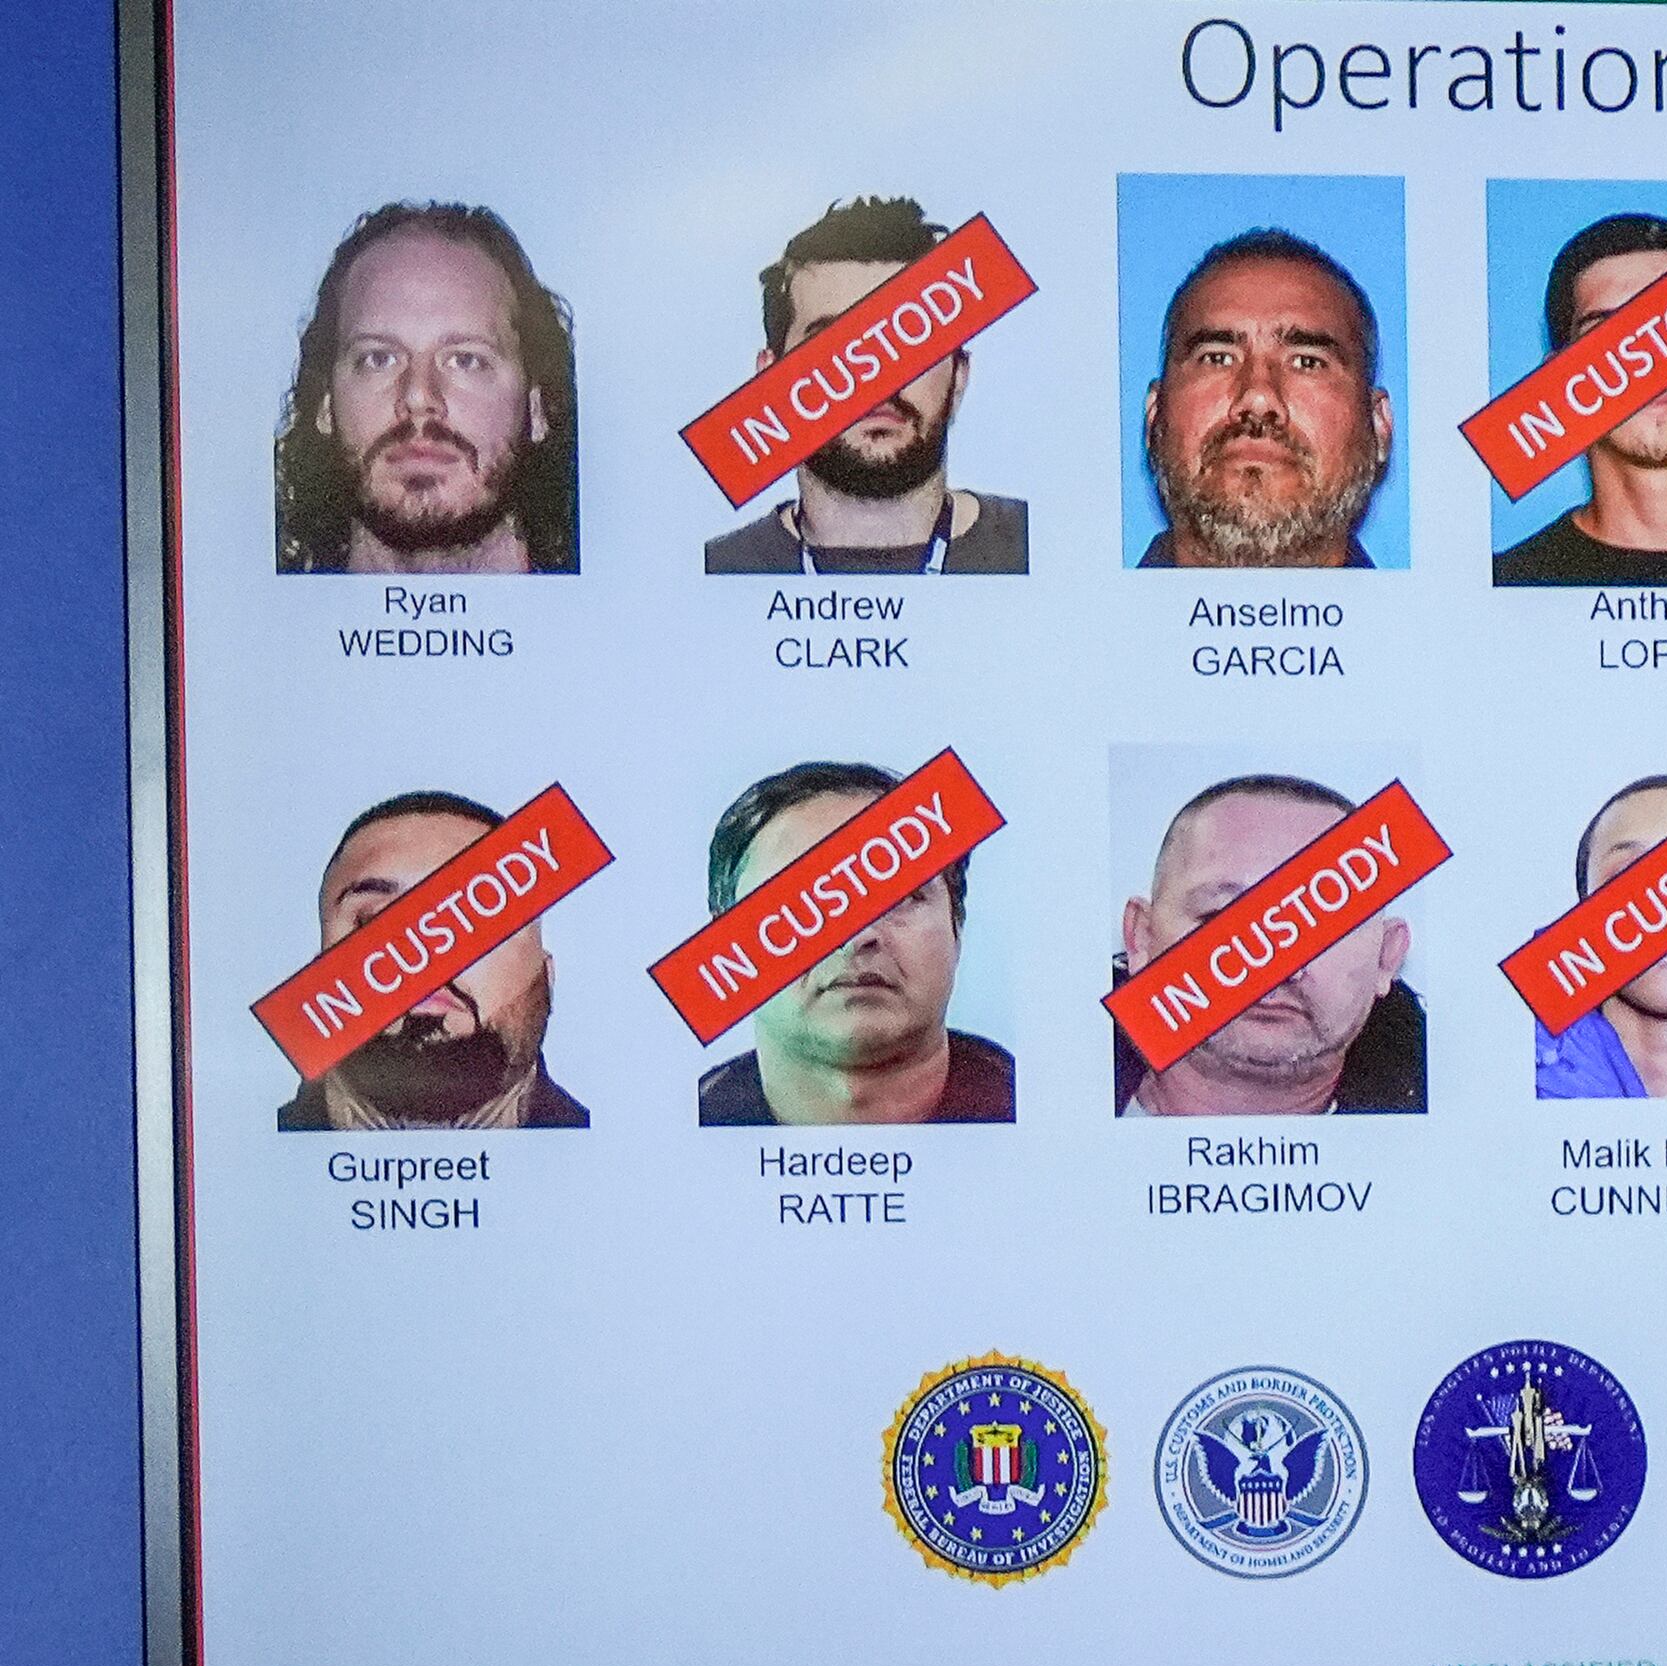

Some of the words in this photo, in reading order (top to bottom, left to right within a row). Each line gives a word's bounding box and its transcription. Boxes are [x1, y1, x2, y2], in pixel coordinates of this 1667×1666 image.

[731, 406, 790, 464] IN
[790, 257, 983, 420] CUSTODY
[1508, 401, 1565, 458] IN
[385, 586, 467, 621] Ryan
[766, 590, 904, 621] Andrew
[1188, 597, 1344, 627] Anselmo
[338, 629, 514, 657] WEDDING
[775, 637, 909, 668] CLARK
[1192, 646, 1345, 676] GARCIA
[699, 943, 758, 1000] IN
[759, 792, 951, 956] CUSTODY
[302, 979, 363, 1039] IN
[363, 828, 560, 994] CUSTODY
[1151, 973, 1209, 1031] IN
[1210, 824, 1398, 986] CUSTODY
[1548, 938, 1605, 996] IN
[760, 1146, 913, 1184] Hardeep
[1188, 1136, 1319, 1167] Rakhim
[1563, 1138, 1652, 1169] Malik
[328, 1150, 490, 1190] Gurpreet
[351, 1198, 479, 1230] SINGH
[779, 1192, 906, 1224] RATTE
[1148, 1181, 1372, 1214] IBRAGIMOV
[1217, 1380, 1248, 1398] AND
[1250, 1377, 1308, 1401] BORDER
[909, 1374, 1003, 1443] DEPARTMENT
[1010, 1376, 1029, 1392] OF
[1031, 1384, 1083, 1441] JUSTICE
[900, 1454, 928, 1531] FEDERAL
[928, 1523, 988, 1565] BUREAU
[993, 1552, 1014, 1566] OF
[1021, 1450, 1091, 1562] INVESTIGATION
